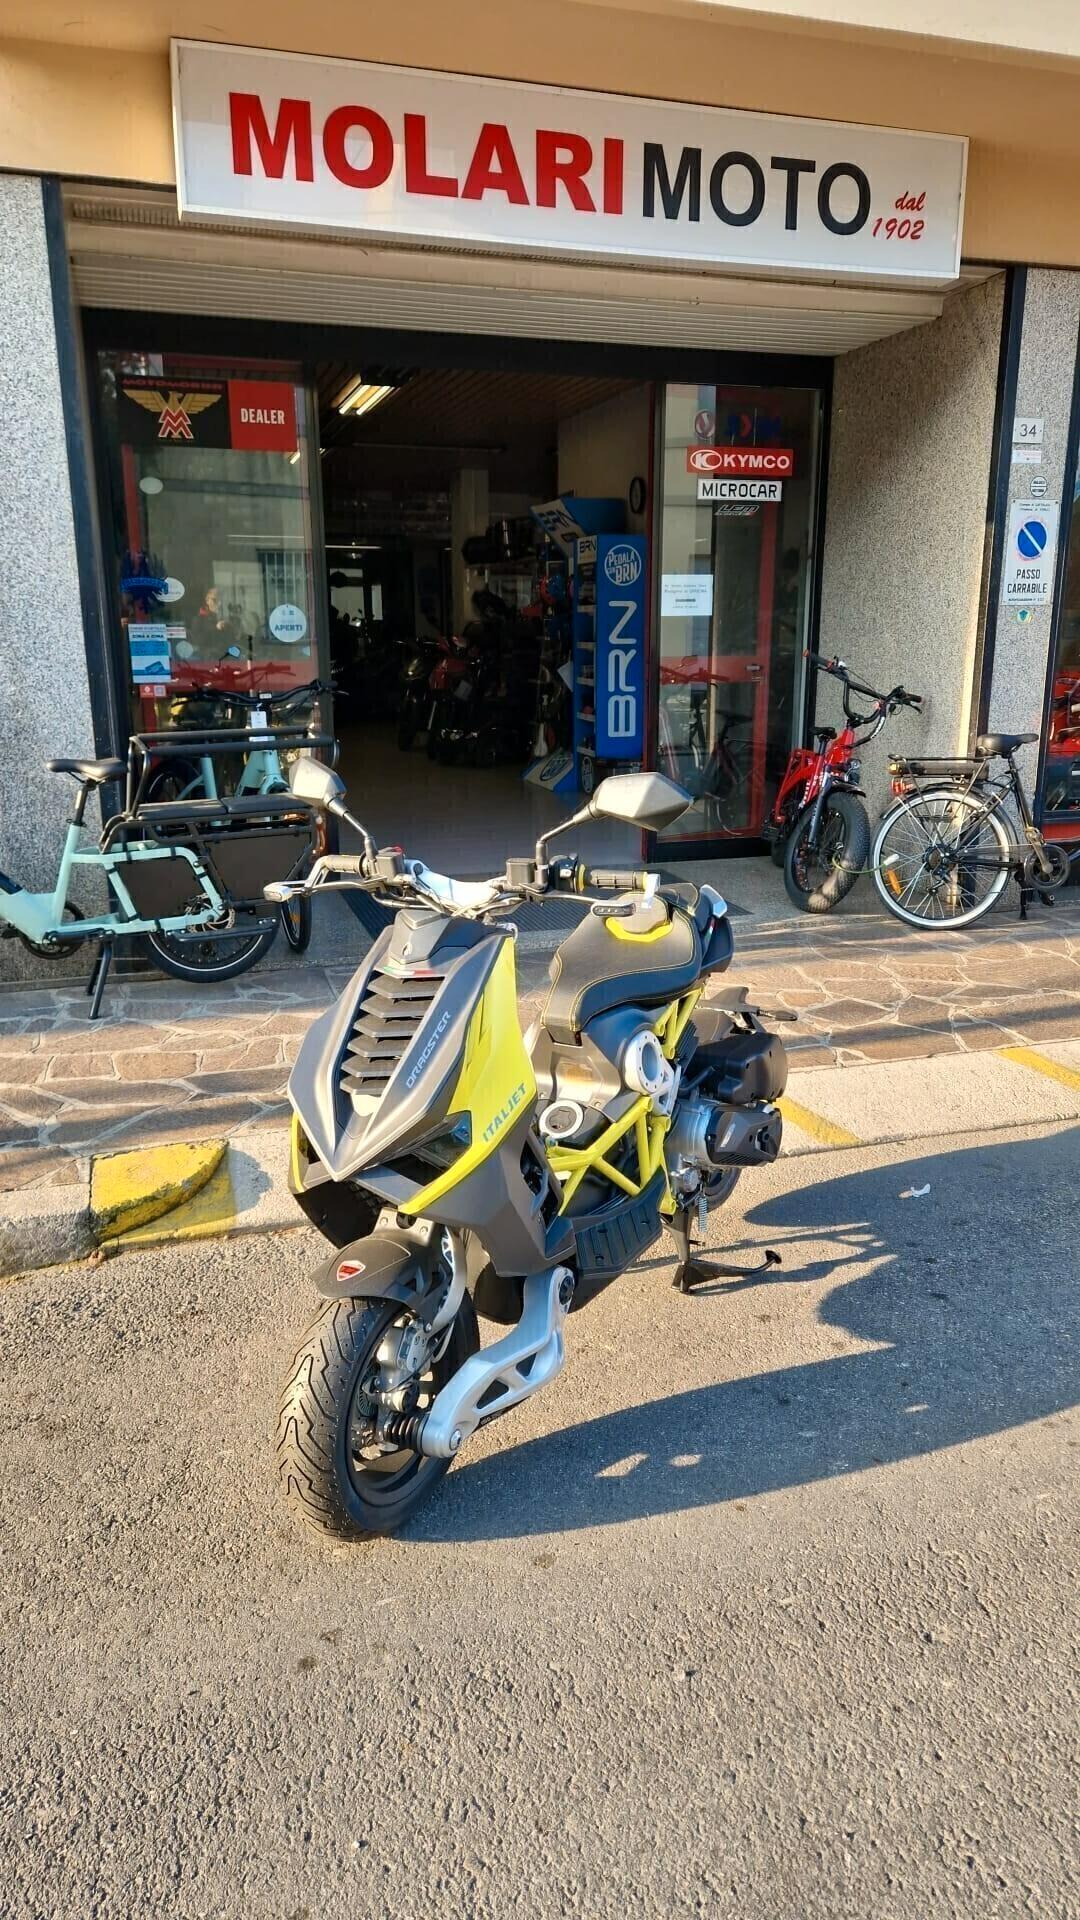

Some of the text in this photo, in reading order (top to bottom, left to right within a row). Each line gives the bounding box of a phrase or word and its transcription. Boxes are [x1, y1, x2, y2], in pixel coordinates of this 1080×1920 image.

[228, 91, 872, 237] MOLARI MOTO
[895, 190, 927, 212] dal
[872, 217, 925, 240] 1902
[240, 407, 285, 425] DEALER
[1019, 424, 1037, 438] 34
[723, 453, 791, 470] KYMCO
[702, 482, 778, 499] MICROCAR
[580, 539, 597, 554] BRN
[608, 550, 636, 567] PEDALA
[615, 560, 638, 584] BRN
[1016, 568, 1041, 580] PASSO
[1007, 582, 1048, 594] CARRABILE
[274, 623, 303, 632] APERTI
[607, 600, 638, 738] BRN
[406, 1010, 451, 1089] DRAGSTER
[482, 1082, 527, 1143] ITALJET
